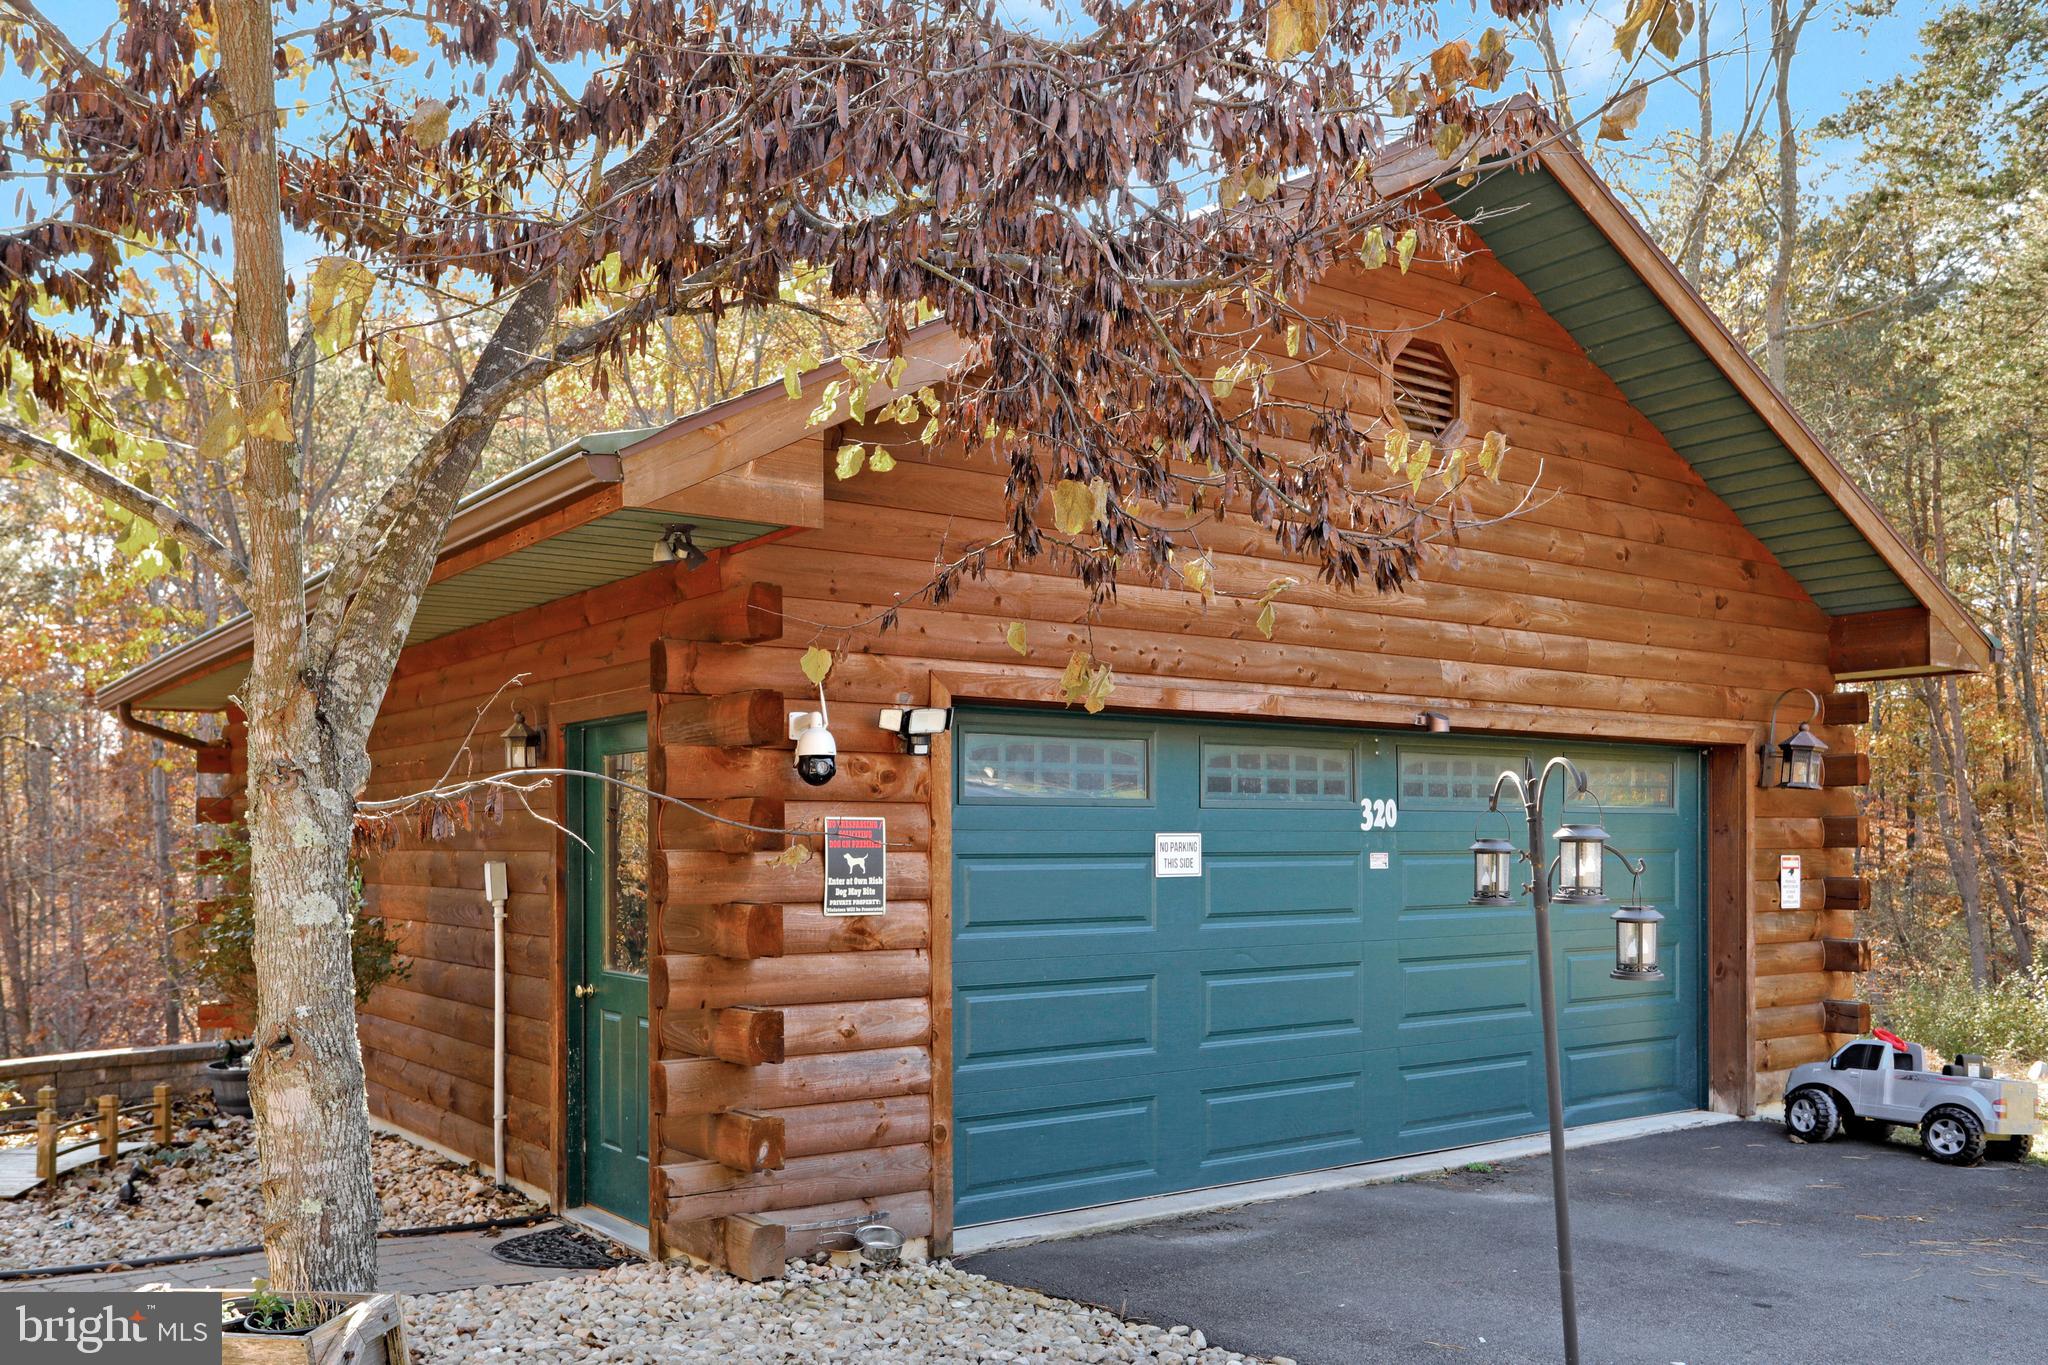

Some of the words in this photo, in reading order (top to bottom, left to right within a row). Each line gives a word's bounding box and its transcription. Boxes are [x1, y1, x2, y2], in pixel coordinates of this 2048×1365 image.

[1361, 798, 1397, 831] 320
[1159, 841, 1169, 853] NO
[1170, 841, 1198, 853] PARKING
[1164, 857, 1178, 869] THIS
[1179, 857, 1194, 869] SIDE
[828, 877, 845, 885] Enter
[846, 877, 853, 885] at
[854, 877, 868, 885] Own
[868, 876, 883, 885] Risk
[835, 887, 847, 898] Dog
[848, 887, 862, 897] May
[862, 886, 876, 895] Bite
